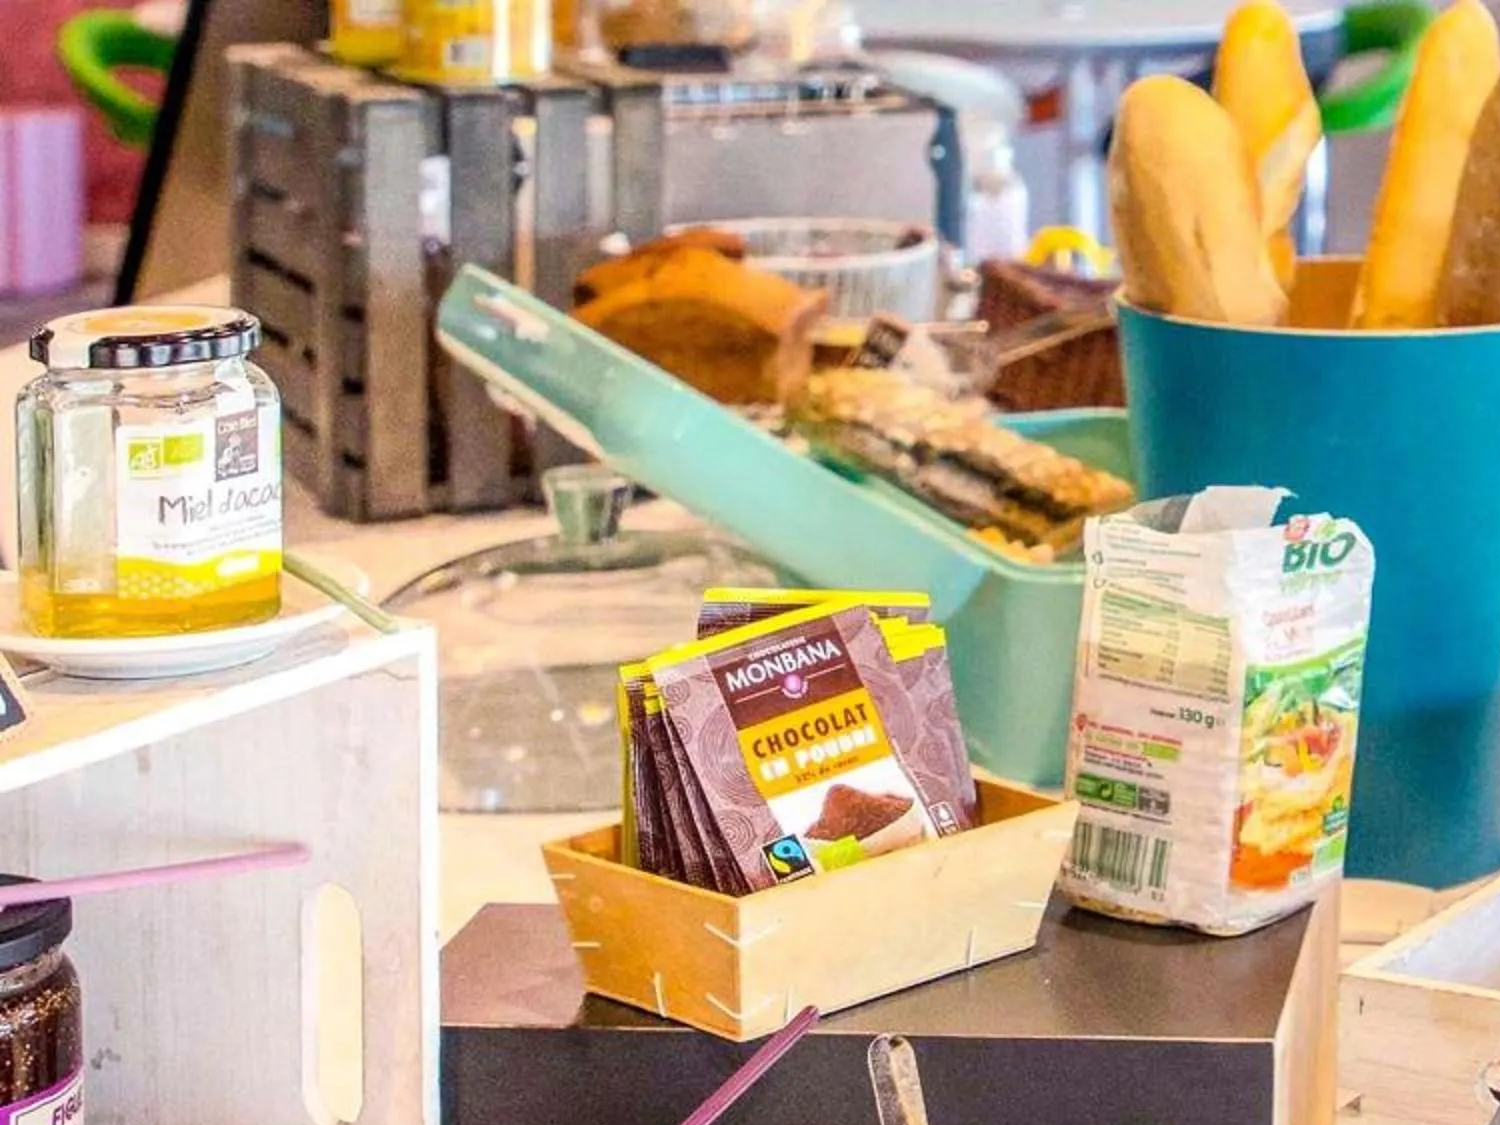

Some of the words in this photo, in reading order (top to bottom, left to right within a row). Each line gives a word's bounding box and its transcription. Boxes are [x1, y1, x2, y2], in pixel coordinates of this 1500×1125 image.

[158, 488, 213, 525] Miel
[1282, 531, 1356, 573] BIO
[725, 638, 842, 692] MONBANA
[752, 703, 869, 759] CHOCOLAT
[1178, 707, 1203, 724] 130
